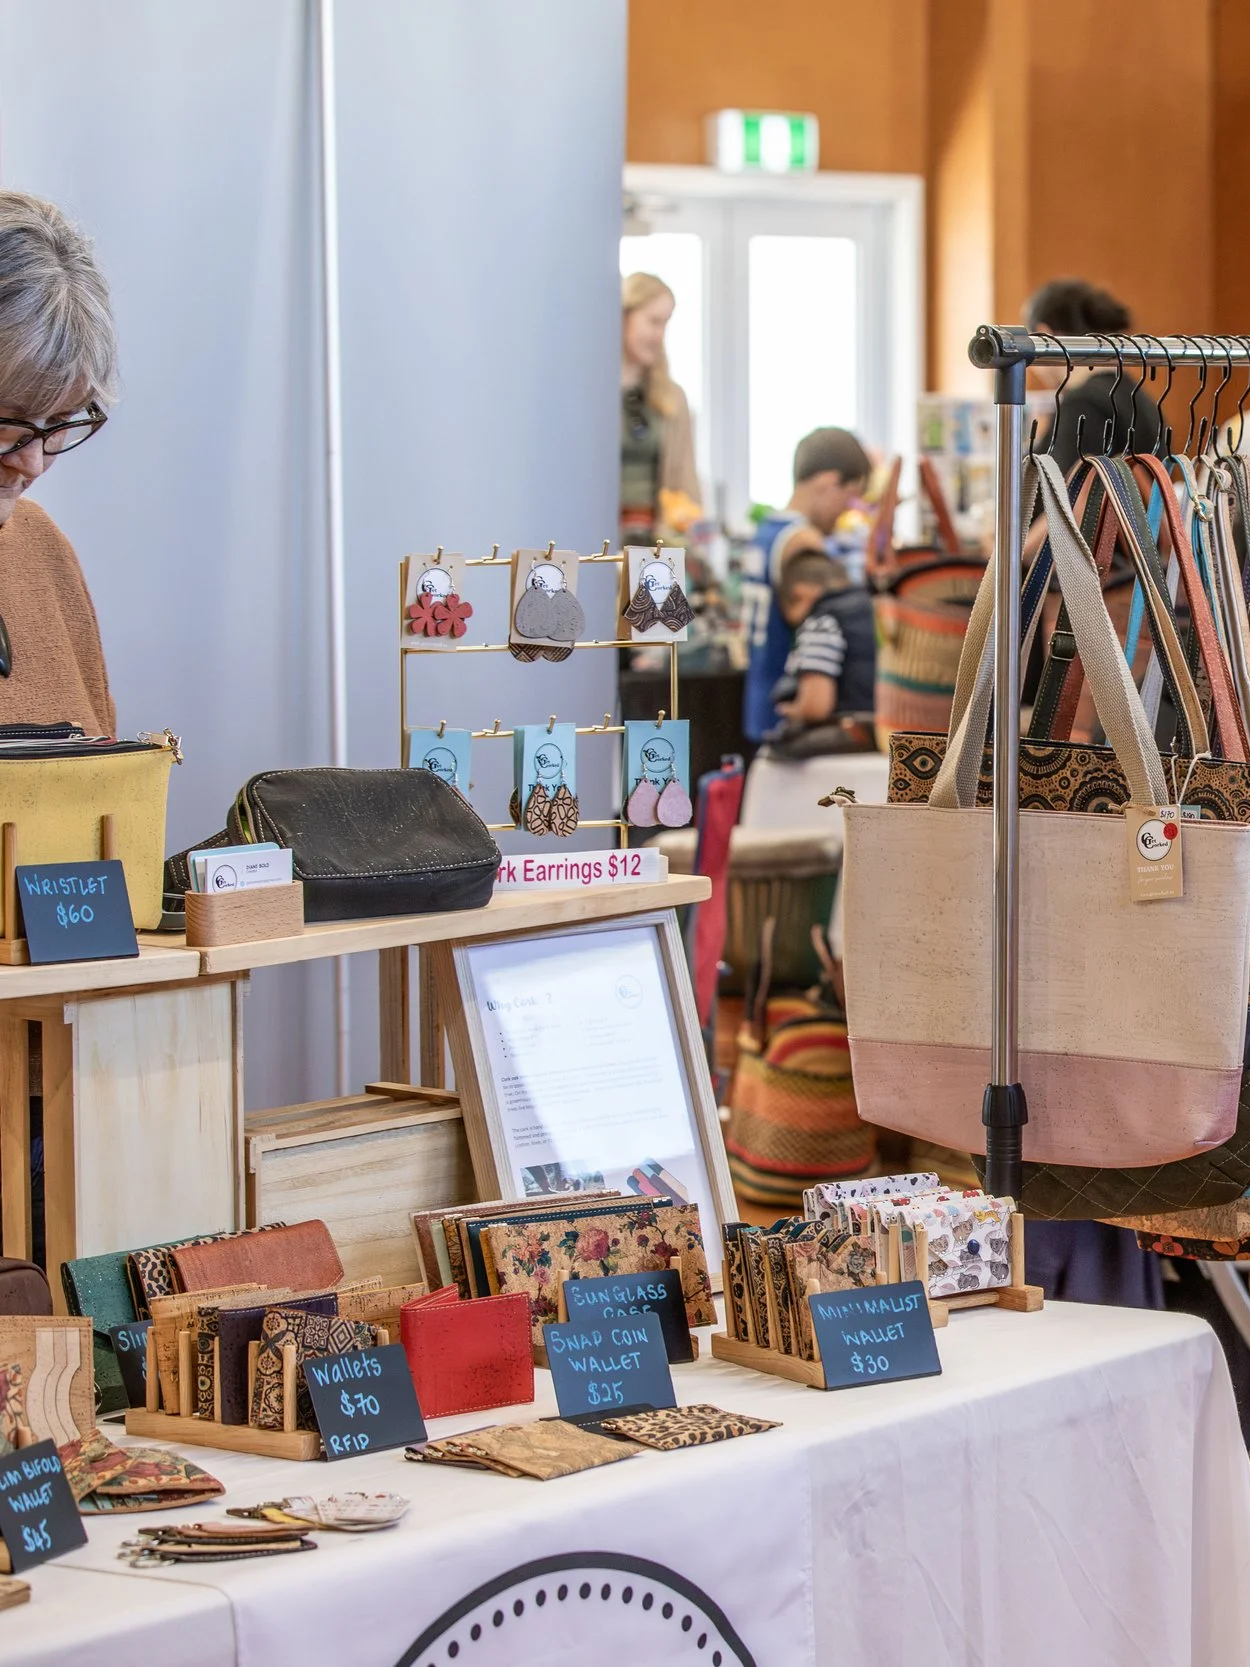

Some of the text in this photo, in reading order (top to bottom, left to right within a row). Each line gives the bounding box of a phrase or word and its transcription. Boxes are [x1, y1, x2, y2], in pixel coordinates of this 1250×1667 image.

[1160, 810, 1175, 819] $170
[523, 858, 602, 885] Earrings
[608, 852, 641, 882] $12
[24, 873, 107, 895] WRISTLET
[56, 902, 94, 928] $60
[550, 1327, 649, 1354] SNAP COIN
[841, 1323, 905, 1346] WALLET
[312, 1352, 382, 1387] Wallets
[568, 1352, 641, 1373] WALLET
[850, 1351, 890, 1375] $30
[340, 1389, 380, 1418] $70
[588, 1380, 624, 1405] $25
[330, 1433, 370, 1456] RFID
[21, 1455, 62, 1480] BIFOLD
[7, 1482, 53, 1513] WALLET
[21, 1518, 51, 1552] $45
